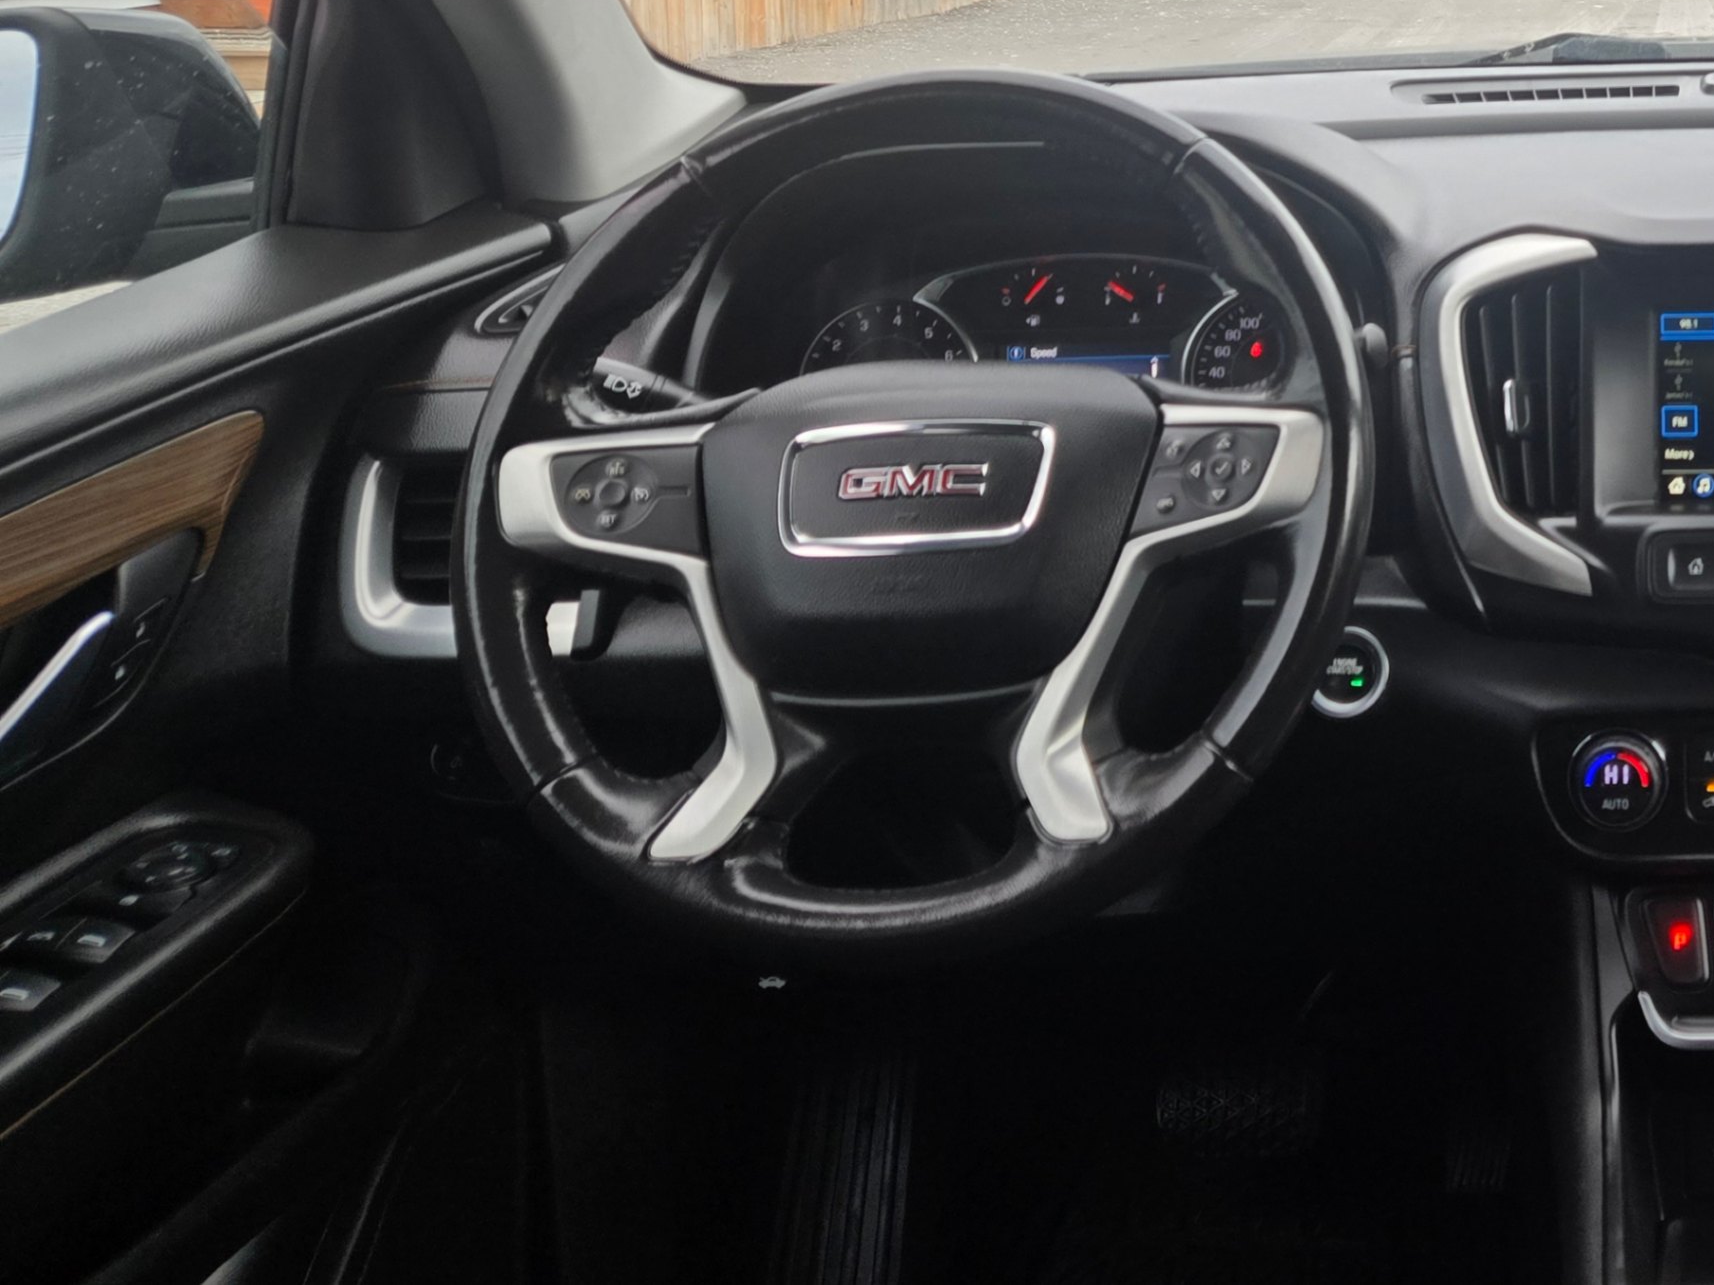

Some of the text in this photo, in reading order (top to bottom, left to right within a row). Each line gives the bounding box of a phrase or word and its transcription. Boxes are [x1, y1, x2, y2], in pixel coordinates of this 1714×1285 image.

[860, 318, 870, 333] 3
[893, 314, 903, 327] 4
[1240, 317, 1260, 330] 100
[924, 326, 934, 340] 5
[1224, 329, 1242, 342] 80
[831, 338, 842, 353] 2
[1214, 345, 1231, 359] 60
[1030, 346, 1058, 360] Speed
[1209, 366, 1226, 379] 40
[1672, 416, 1688, 428] FM
[838, 462, 989, 501] GMC
[1604, 764, 1630, 785] HI
[1602, 798, 1630, 810] AUTO
